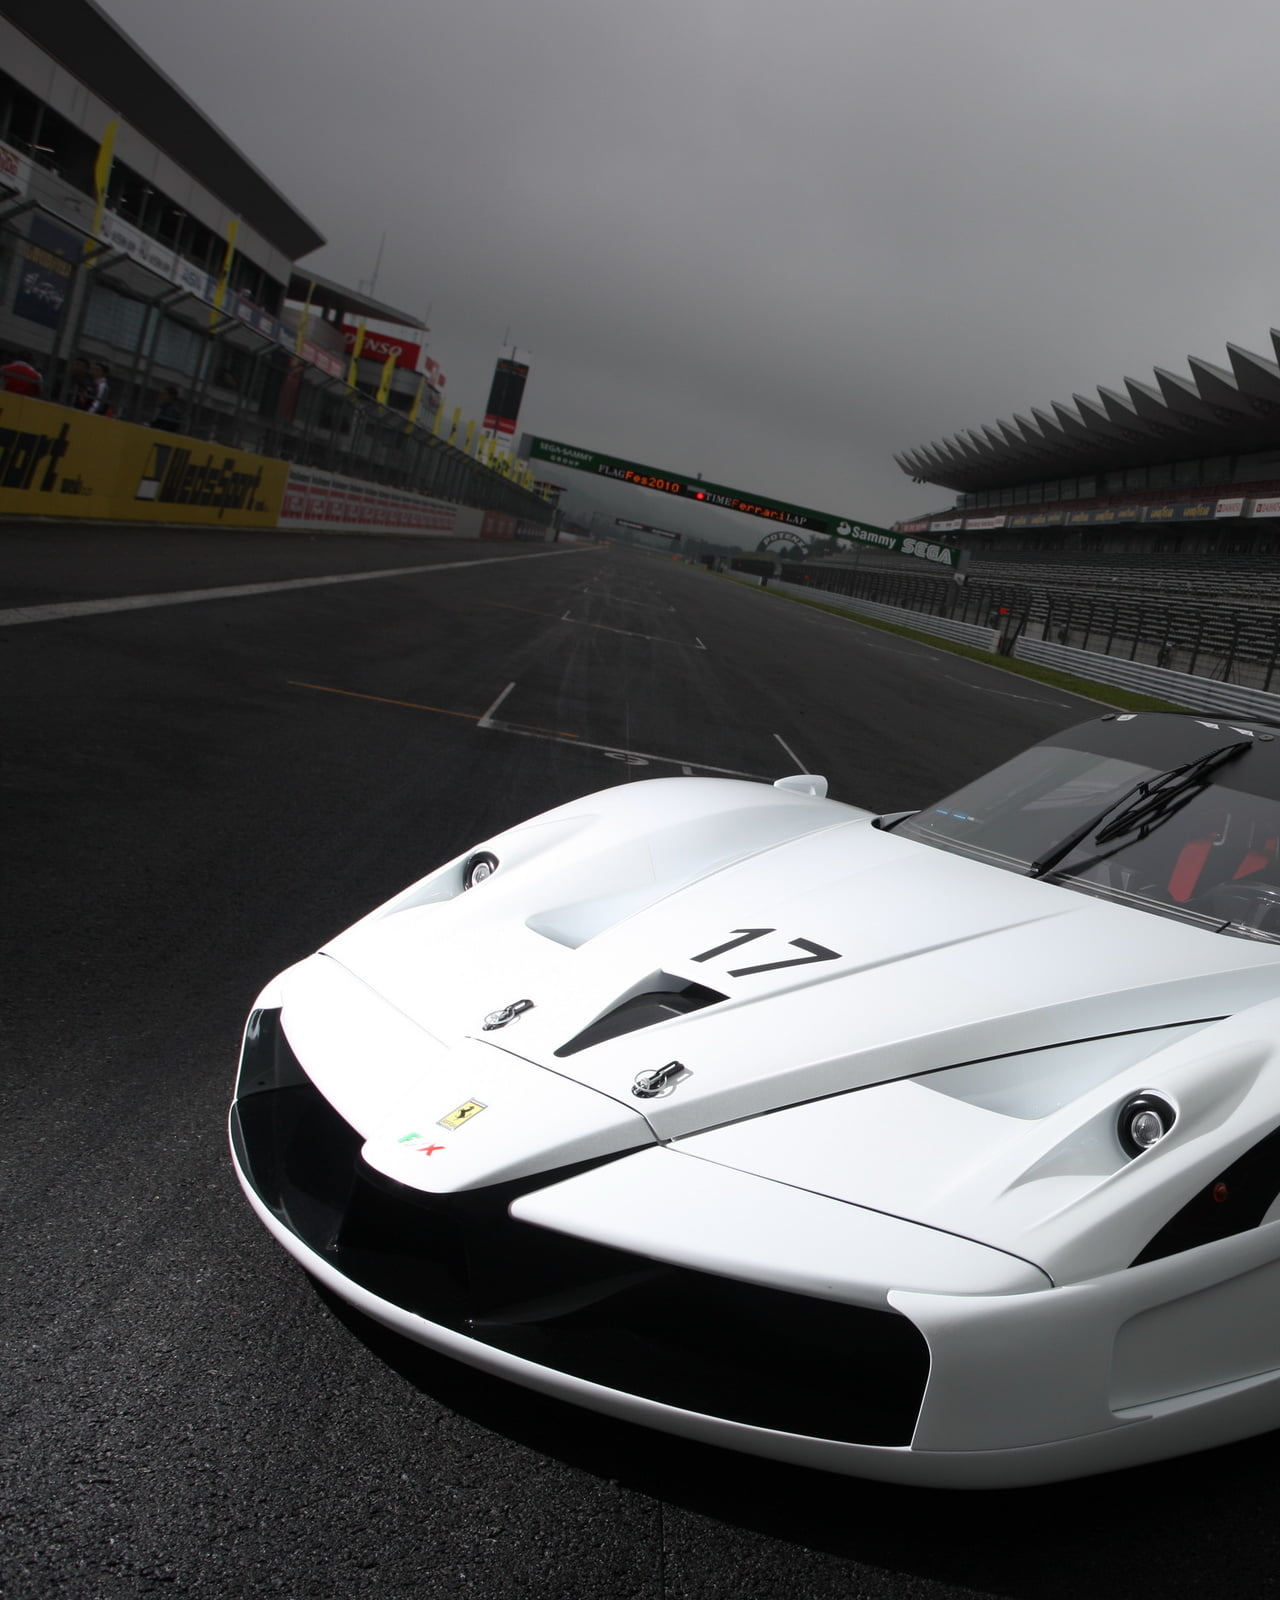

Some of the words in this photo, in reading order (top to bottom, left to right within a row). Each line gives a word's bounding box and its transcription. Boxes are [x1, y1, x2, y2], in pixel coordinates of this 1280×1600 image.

[345, 332, 403, 357] DNSO
[598, 463, 625, 479] FLAG
[705, 492, 732, 507] TIME
[731, 498, 786, 521] Ferrari
[786, 513, 808, 526] LAP
[763, 533, 808, 555] POTENZA
[852, 526, 897, 550] Sammy
[901, 538, 952, 565] SEGA
[690, 928, 842, 977] 17
